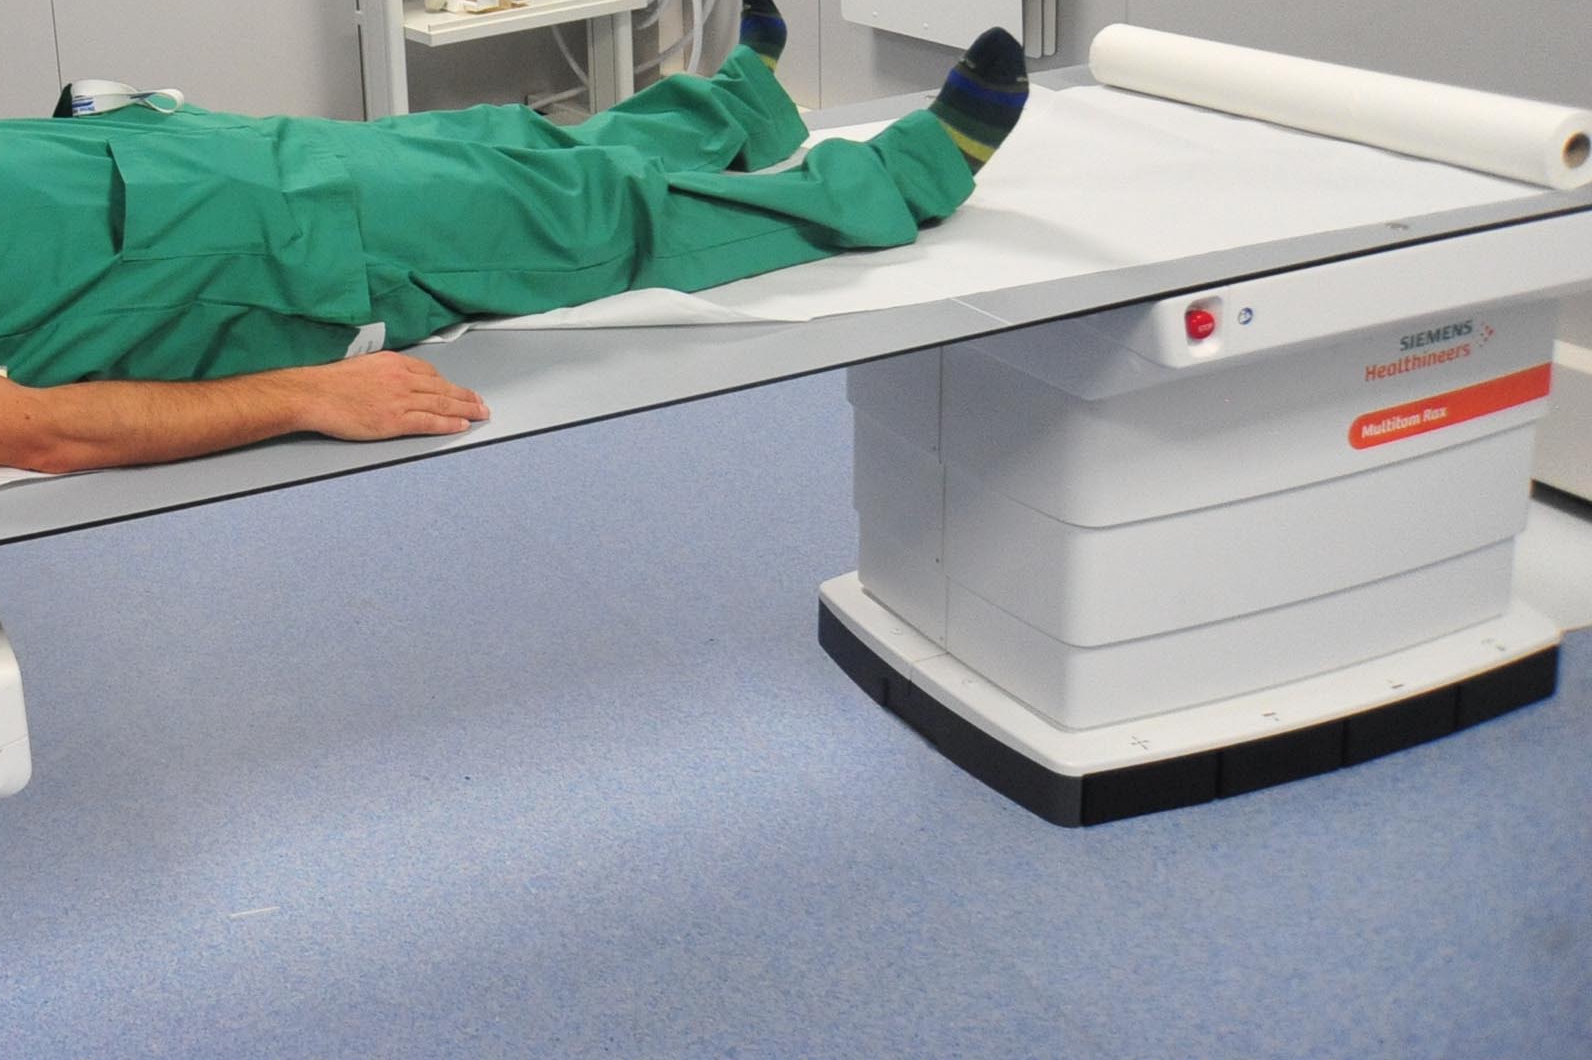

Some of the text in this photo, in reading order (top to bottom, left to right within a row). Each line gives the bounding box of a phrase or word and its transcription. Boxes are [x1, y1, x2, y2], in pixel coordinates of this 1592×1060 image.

[1400, 320, 1472, 352] SIEMENS
[1365, 342, 1471, 381] Healthineers
[1361, 407, 1448, 438] Multitom Rax
